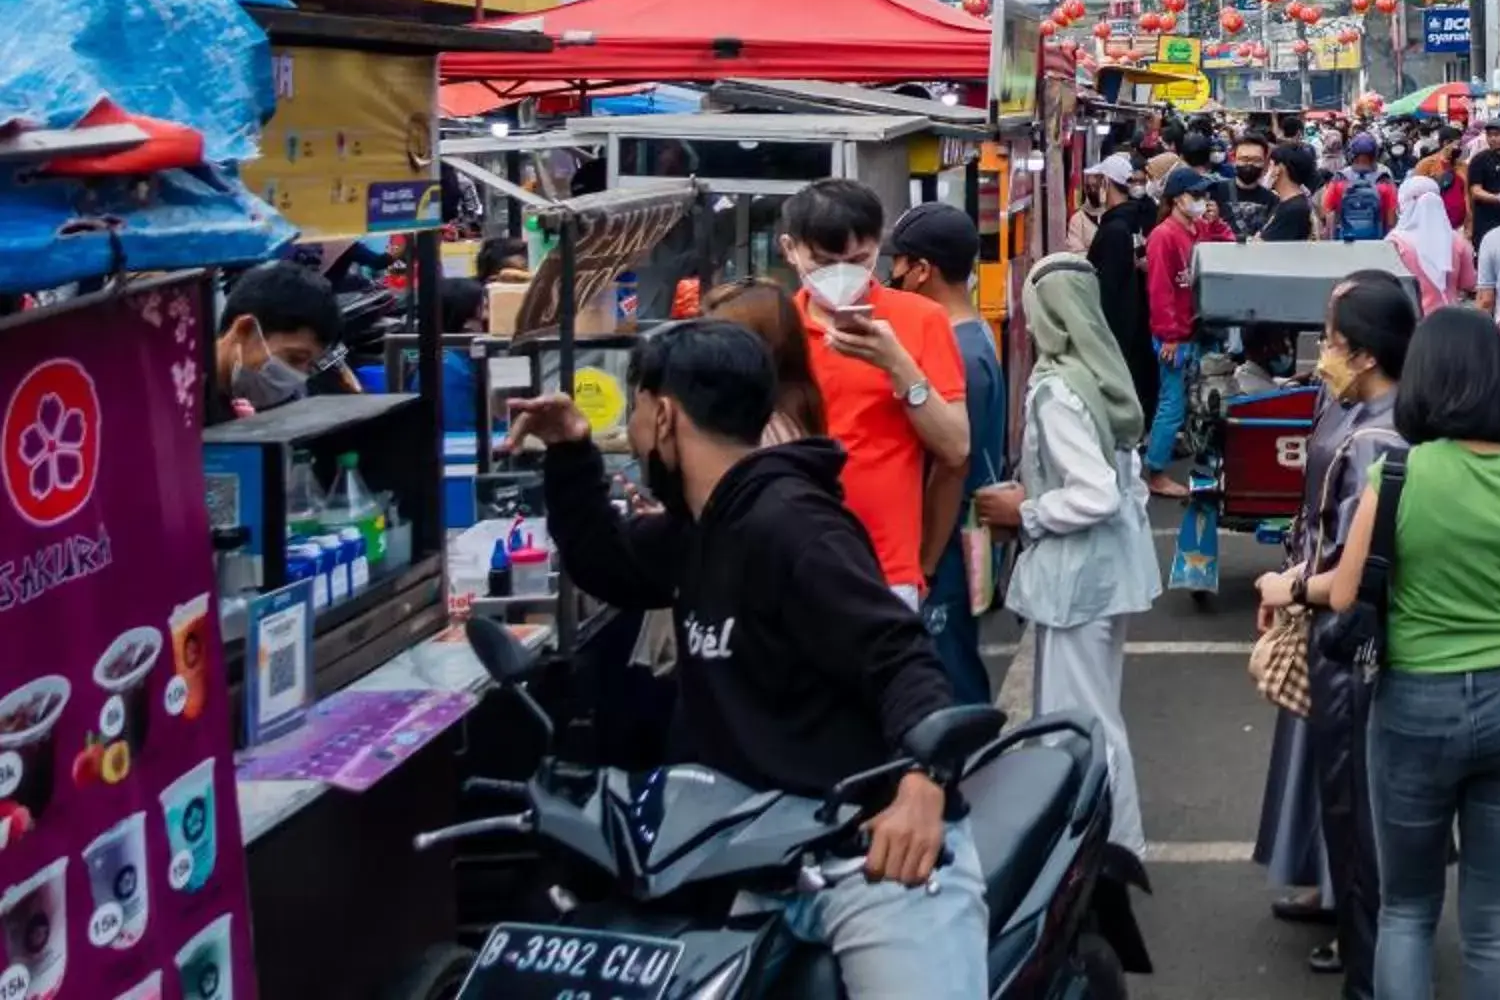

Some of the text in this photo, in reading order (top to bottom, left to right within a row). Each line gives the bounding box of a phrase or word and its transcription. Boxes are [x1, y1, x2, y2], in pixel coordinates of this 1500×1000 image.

[479, 931, 671, 987] B 3392 CLU
